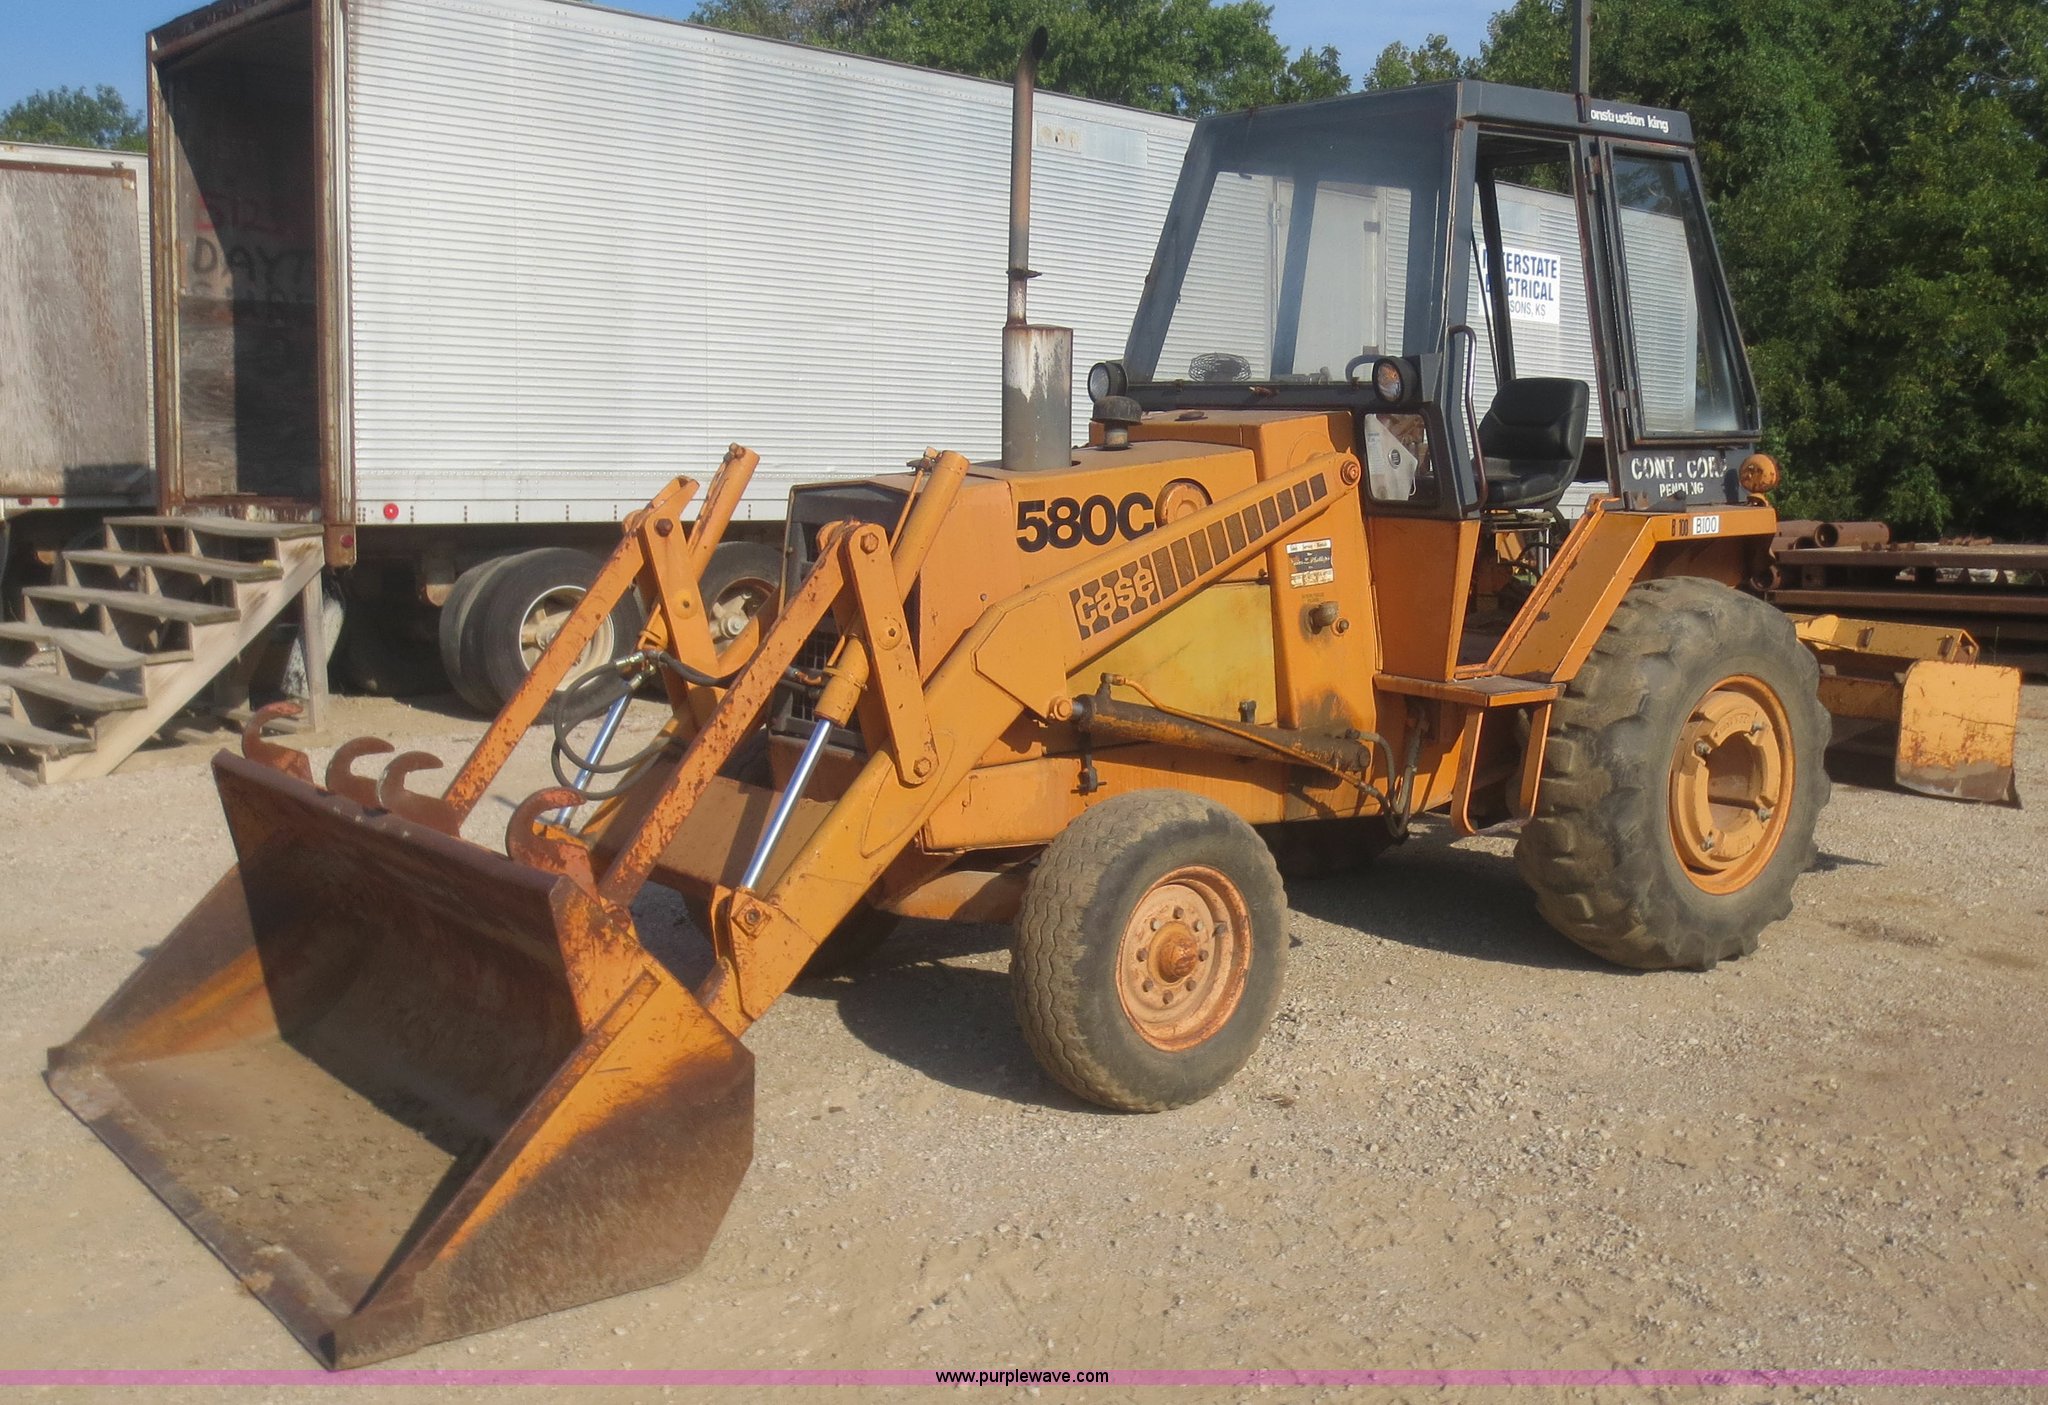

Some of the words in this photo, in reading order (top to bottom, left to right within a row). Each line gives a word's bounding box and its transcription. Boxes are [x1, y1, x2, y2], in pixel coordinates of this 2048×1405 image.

[1590, 104, 1646, 127] onstruction
[1647, 114, 1669, 133] king
[1482, 248, 1557, 279] IERSTATE
[1485, 273, 1554, 301] ECTRICAL
[1509, 299, 1534, 317] SONS,
[1535, 303, 1546, 317] KS
[1631, 456, 1682, 480] CONT.
[1659, 481, 1704, 497] PENDING
[1016, 491, 1155, 552] 580C
[1073, 563, 1156, 632] case
